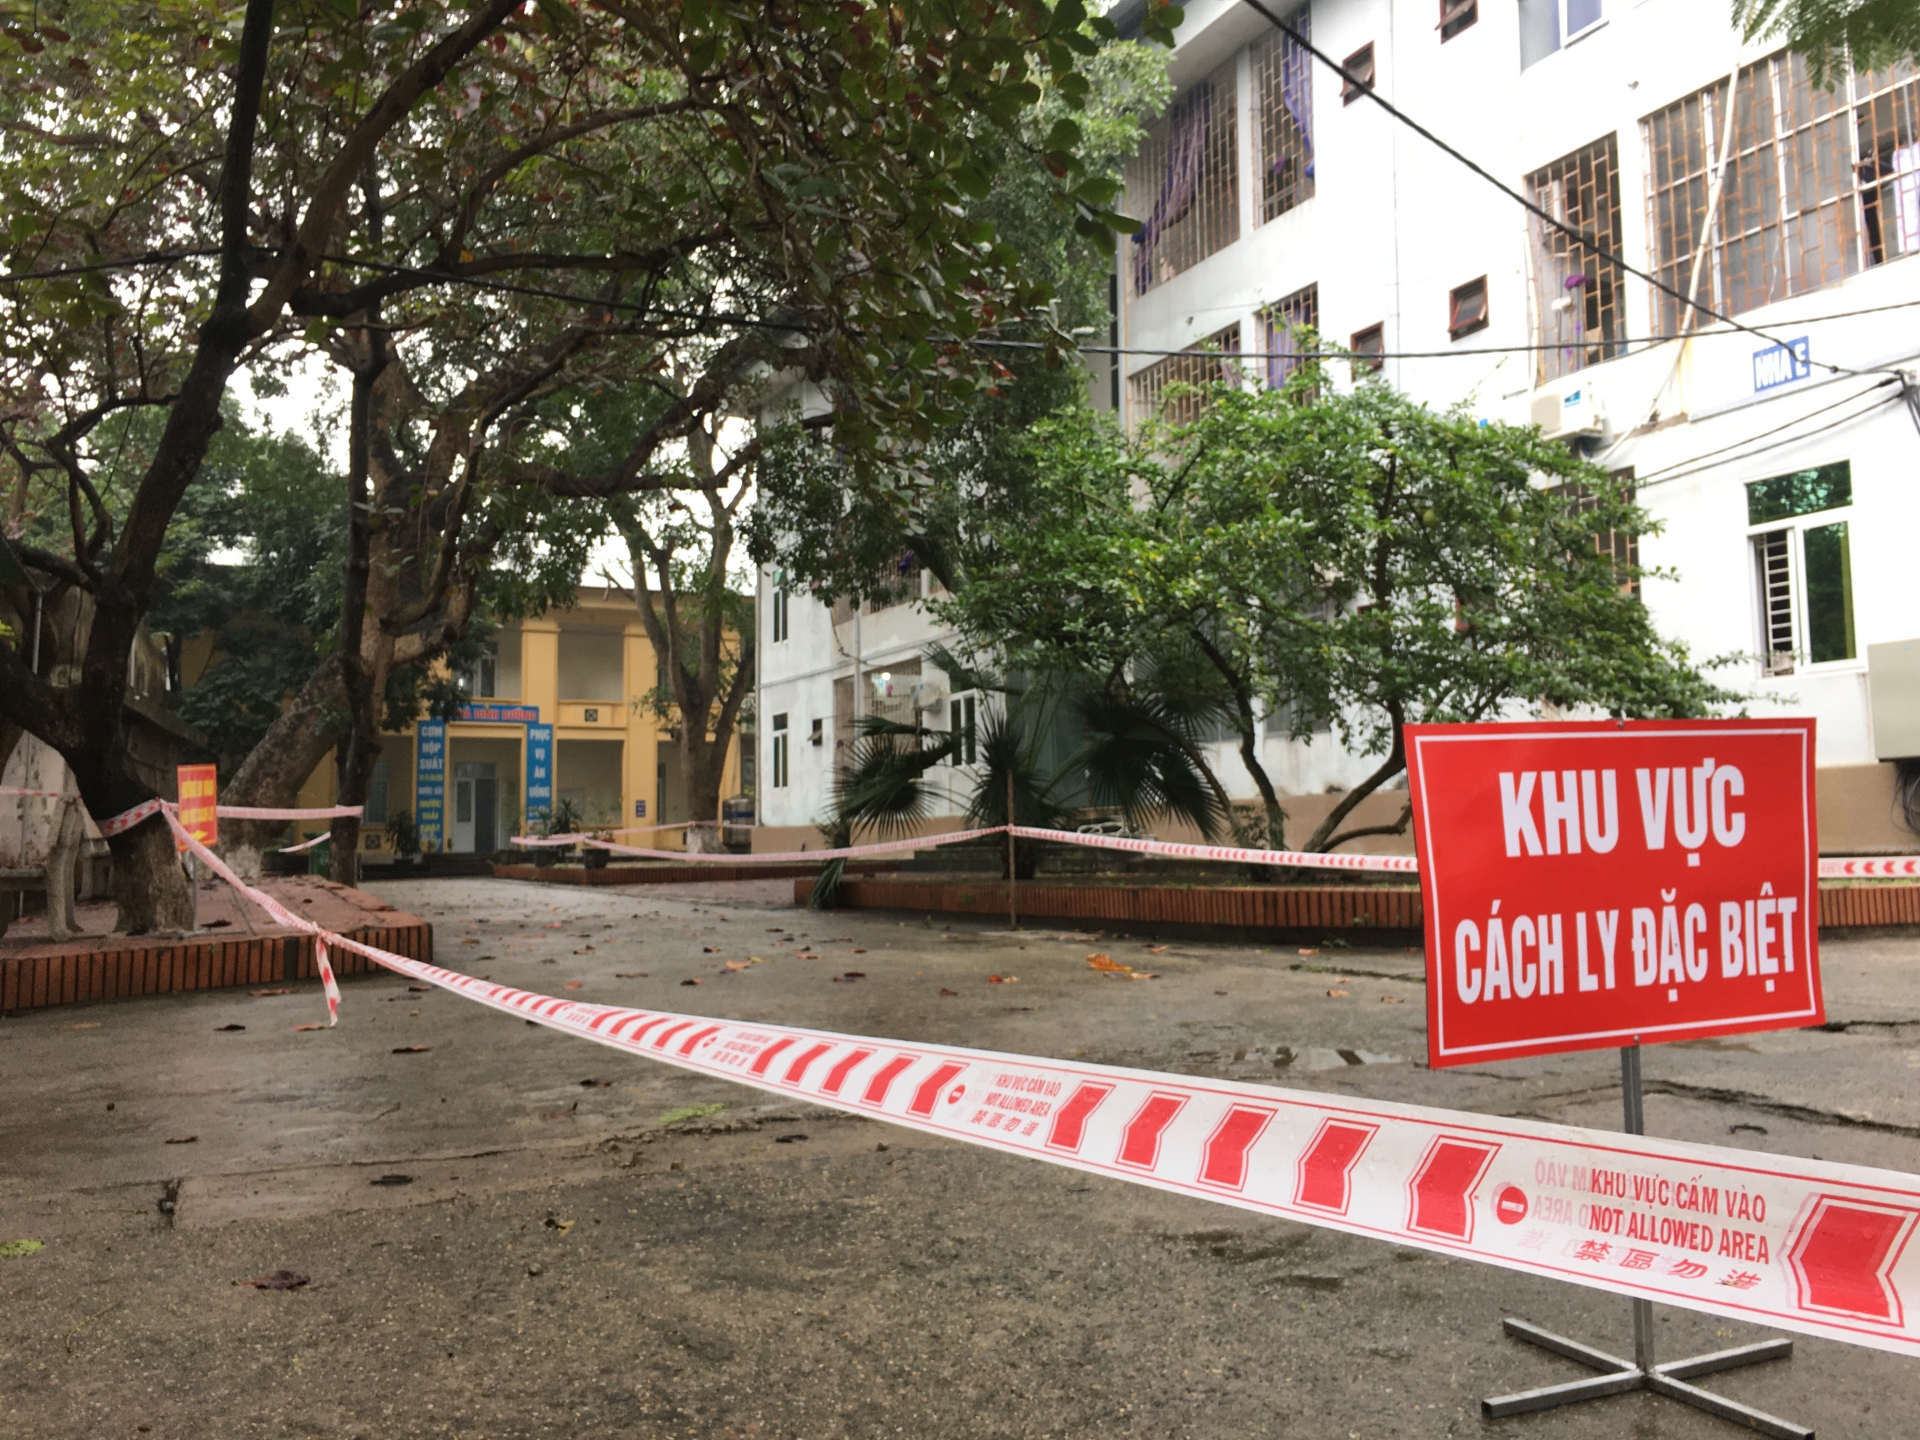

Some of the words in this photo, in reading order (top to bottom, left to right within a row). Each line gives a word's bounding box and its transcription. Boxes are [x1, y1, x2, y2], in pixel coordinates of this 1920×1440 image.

[1498, 769, 1619, 858] KHU
[1636, 757, 1746, 867] VỰC
[1454, 899, 1564, 1004] CÁCH
[1576, 909, 1619, 992] LY
[1631, 887, 1708, 1002] ĐẶC
[1720, 882, 1797, 992] BIỆT
[1589, 1205, 1624, 1235] NOT
[1627, 1212, 1714, 1253] ALLOWED
[1718, 1228, 1770, 1265] AREA
[1591, 1168, 1626, 1198] KHU
[1633, 1174, 1669, 1209] VỰC
[1676, 1175, 1718, 1215] CẤM
[1725, 1184, 1766, 1223] VÀO
